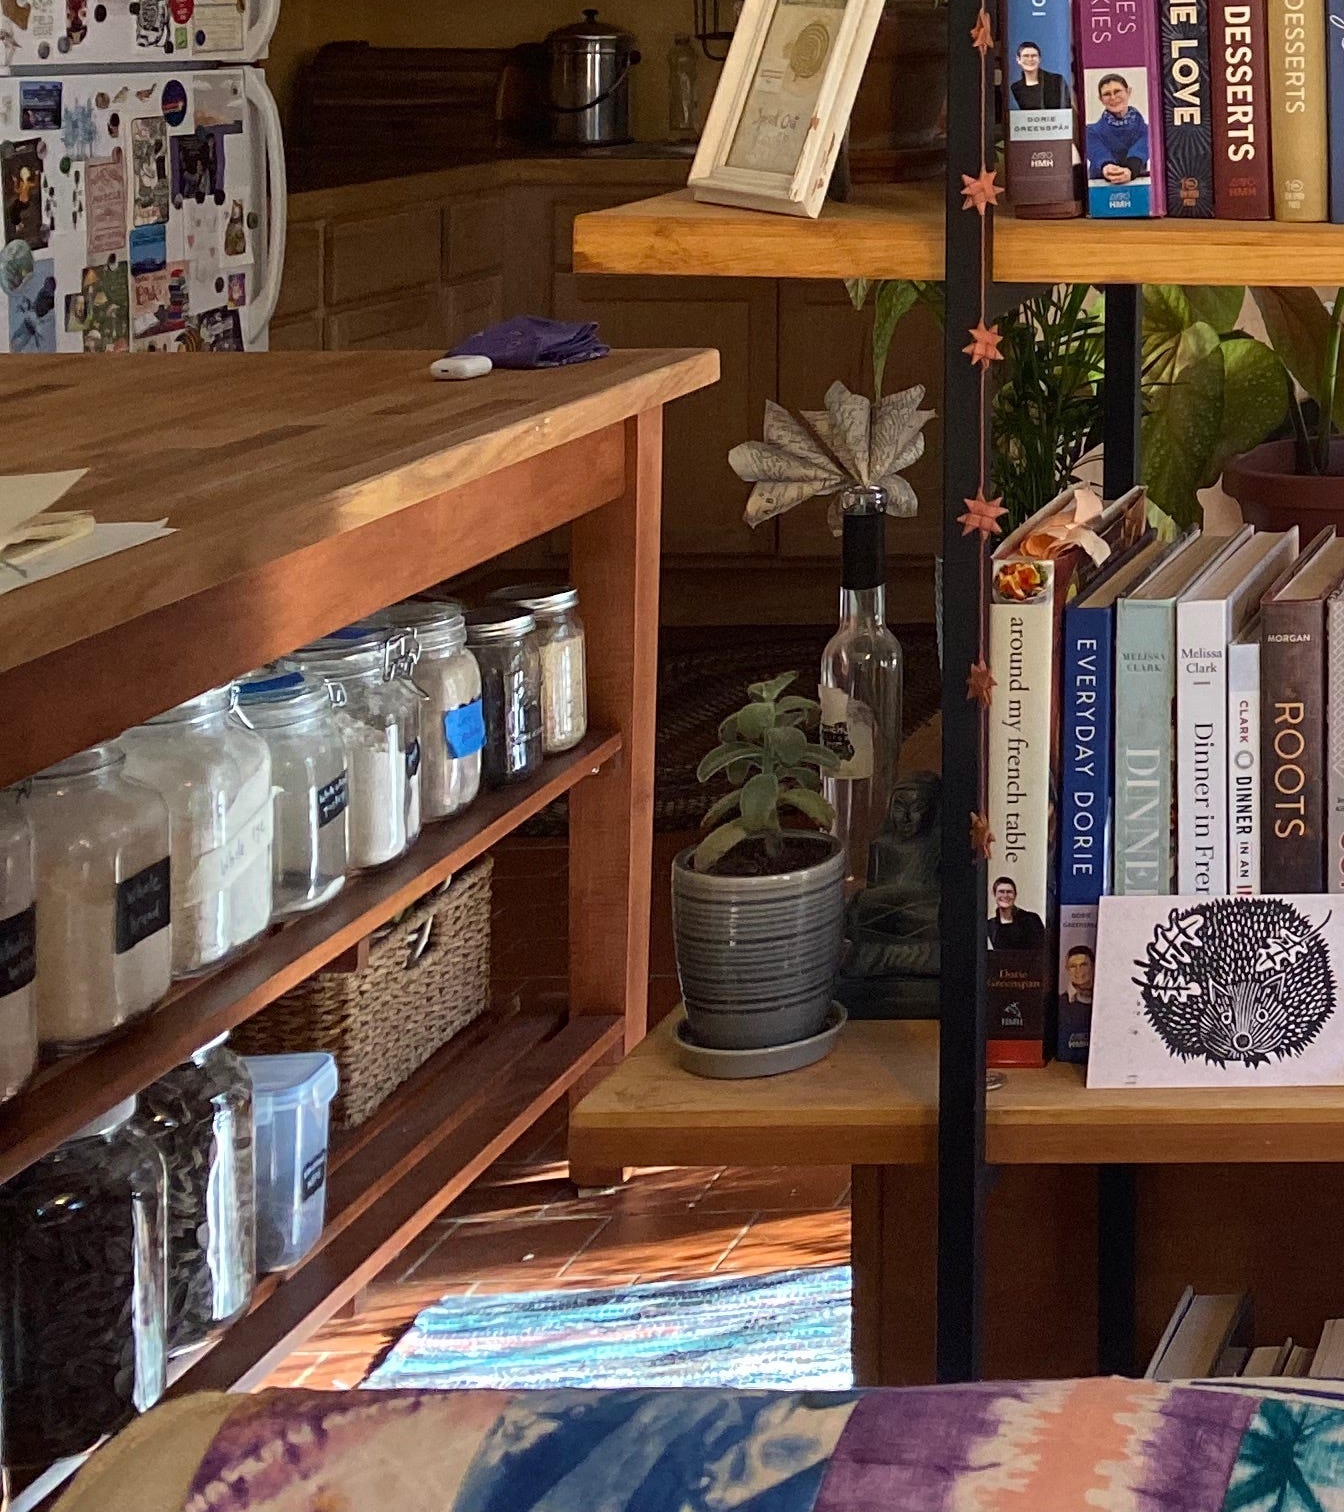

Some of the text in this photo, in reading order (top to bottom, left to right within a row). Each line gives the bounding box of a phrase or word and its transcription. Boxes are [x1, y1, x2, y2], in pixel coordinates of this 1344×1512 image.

[1172, 39, 1200, 126] LOVE
[1224, 5, 1254, 162] DESSERTS
[1181, 647, 1223, 660] Melissa
[1186, 662, 1218, 674] Clark
[1267, 634, 1311, 643] MORGAN
[1003, 617, 1027, 864] around my french table
[1072, 639, 1097, 876] EVERYDAY DORIE
[1273, 701, 1305, 839] ROOTS
